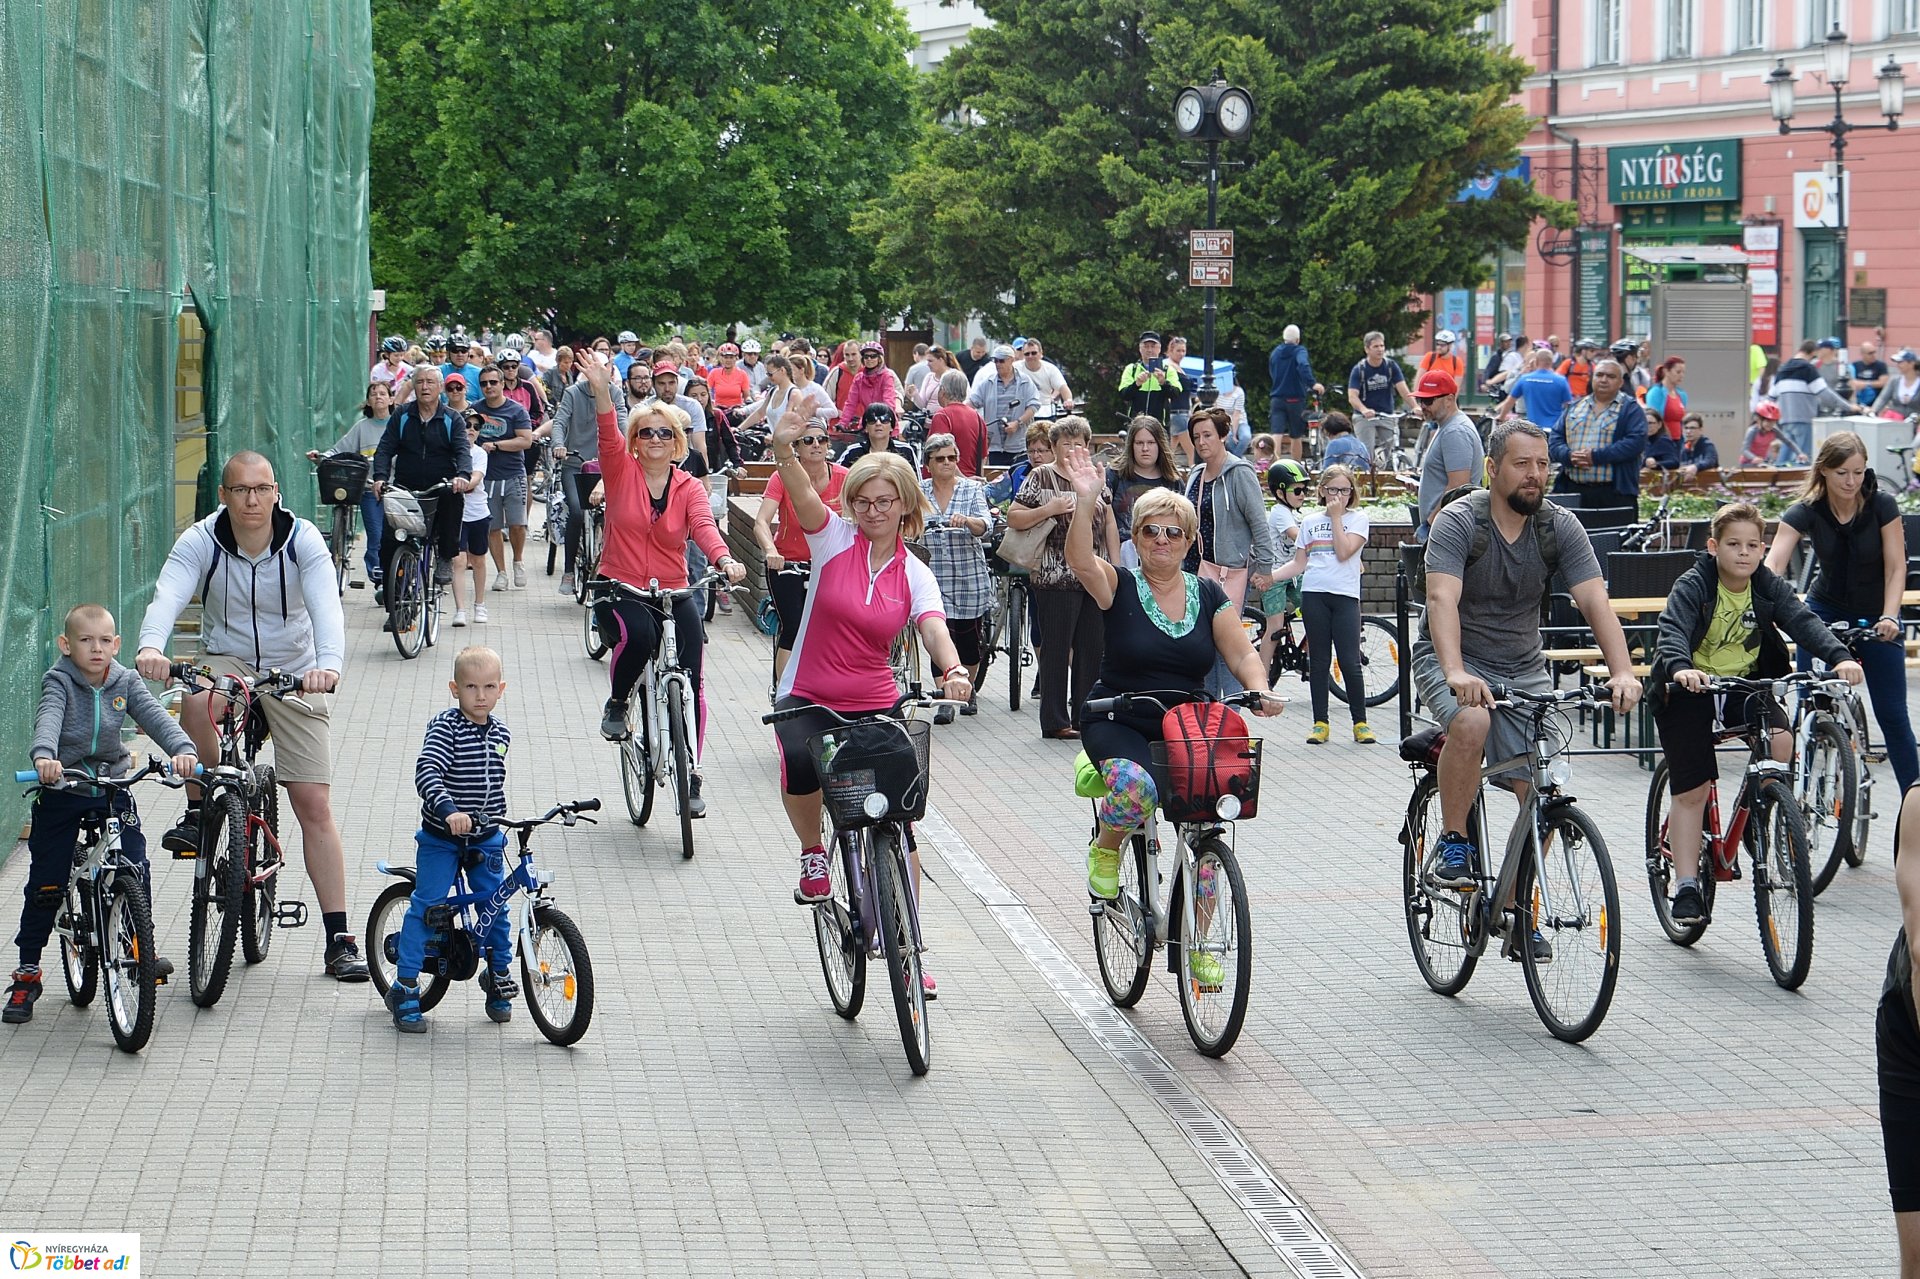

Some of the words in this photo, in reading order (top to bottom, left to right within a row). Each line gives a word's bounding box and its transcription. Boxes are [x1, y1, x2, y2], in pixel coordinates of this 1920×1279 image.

[1621, 145, 1724, 187] NYÍRSÉG
[1621, 186, 1673, 202] UTAZÁSI
[1683, 186, 1723, 199] IRODA
[474, 885, 511, 938] POLICE
